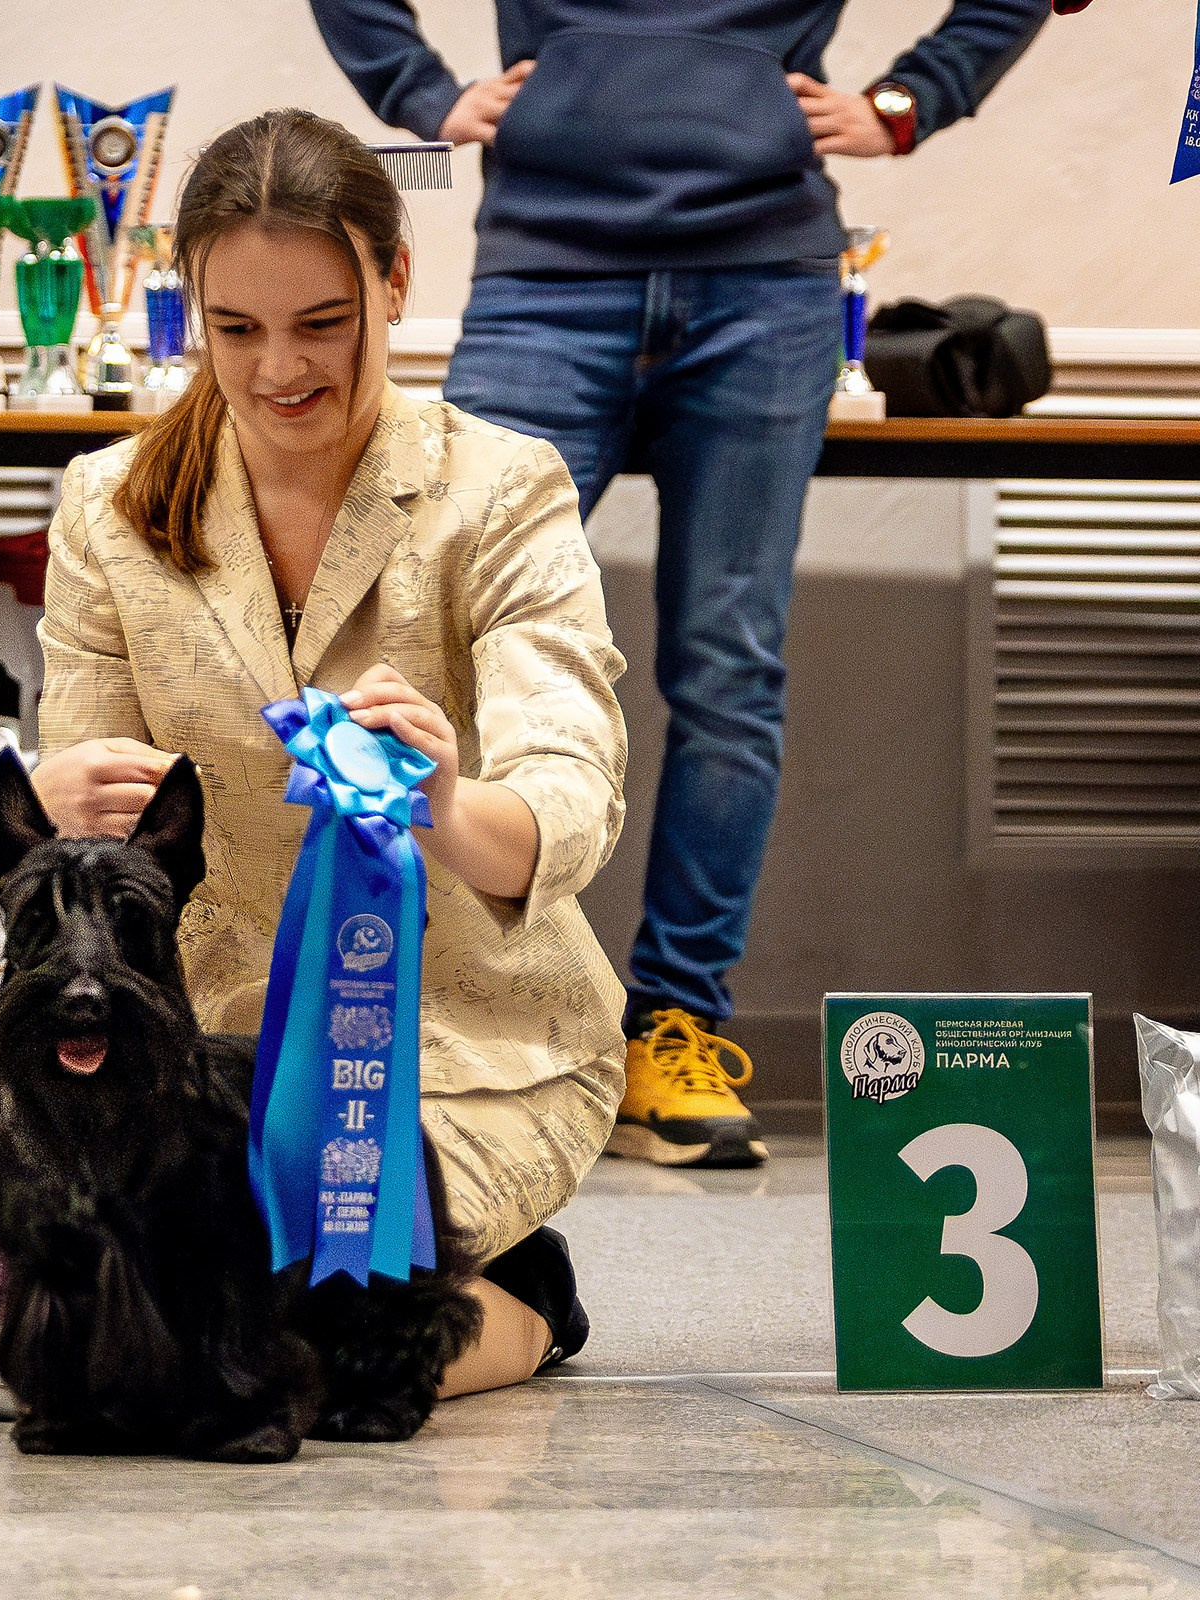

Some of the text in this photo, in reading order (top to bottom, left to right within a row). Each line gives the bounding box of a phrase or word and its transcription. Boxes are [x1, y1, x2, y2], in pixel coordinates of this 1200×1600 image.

[935, 1020, 1024, 1028] ПЕРМСКАЯ КРАЕВАЯ
[935, 1030, 1072, 1038] ОБЩЕСТВЕННАЯ ОРГАНИЗАЦИЯ
[845, 1016, 921, 1073] КИНОЛОГИЧЕСКИЙ КЛУБ
[935, 1040, 1042, 1048] КИНОЛОГИЧЕСКИЙ КЛУБ
[936, 1053, 1011, 1068] ПАРМА
[332, 1059, 386, 1090] BIG
[852, 1072, 919, 1105] Парма
[897, 1123, 1039, 1358] 3
